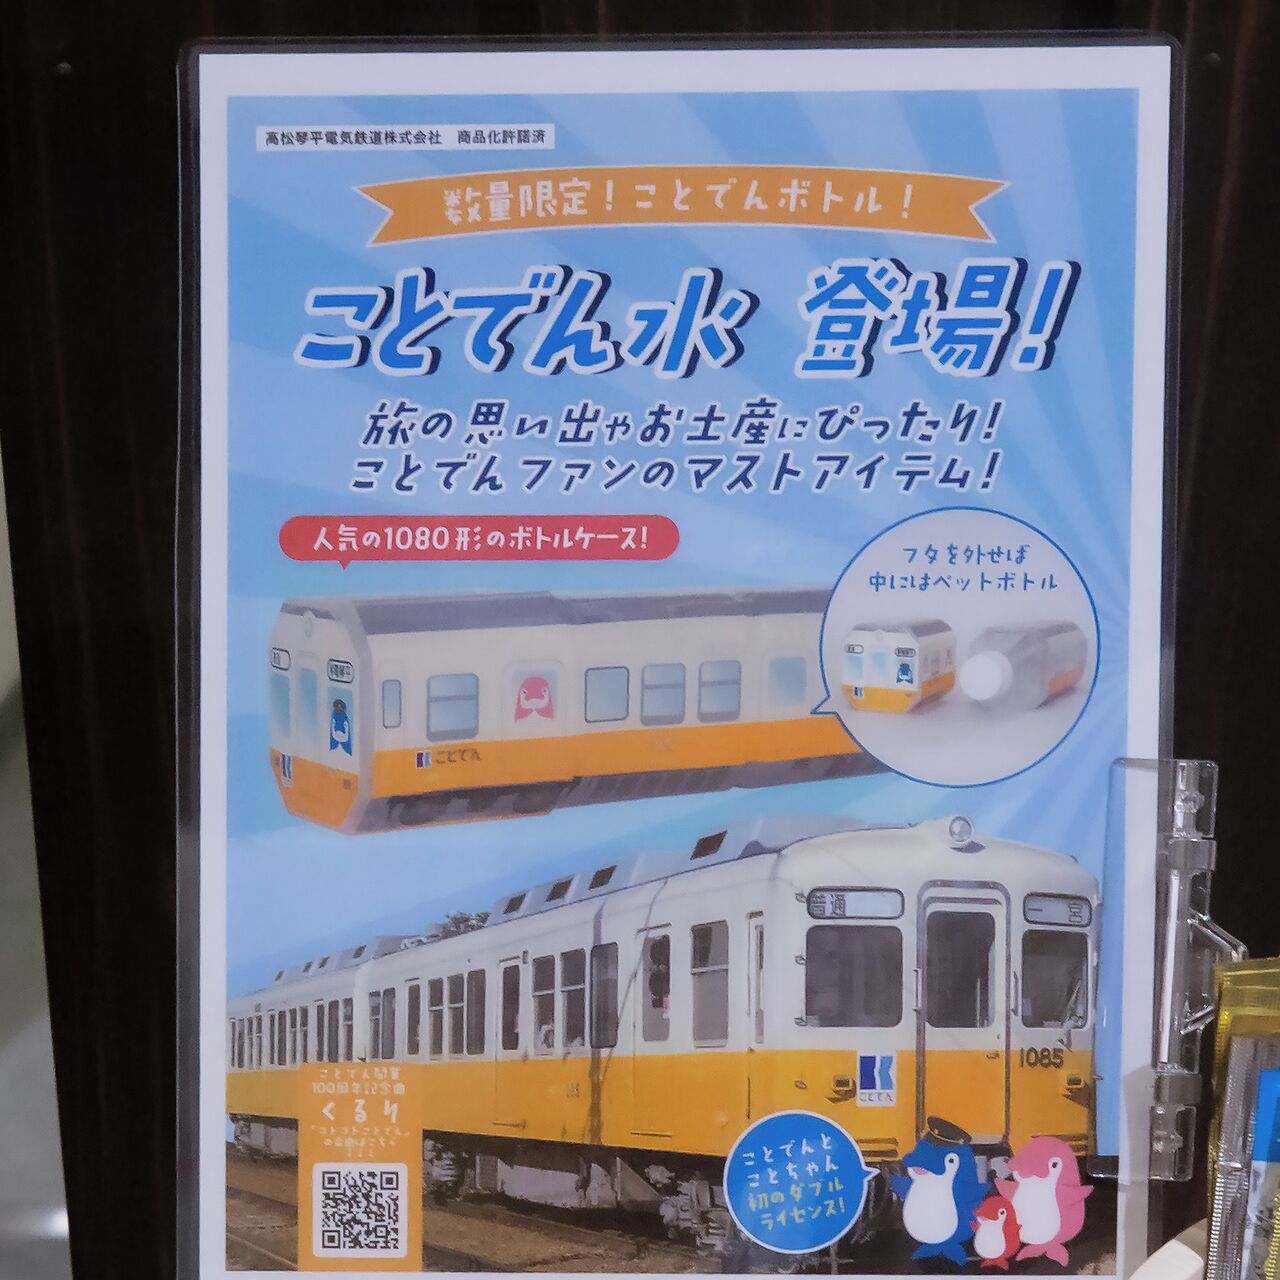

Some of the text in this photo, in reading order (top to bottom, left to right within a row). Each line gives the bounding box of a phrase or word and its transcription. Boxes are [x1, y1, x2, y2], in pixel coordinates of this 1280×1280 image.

[265, 129, 442, 146] 高松琴平電気鉄道株式会社
[294, 266, 758, 377] ことでん水
[902, 544, 1030, 565] フタを外せば
[869, 571, 1058, 592] 中にはペットボトル
[1019, 1047, 1064, 1069] 1085
[322, 1098, 399, 1123] くるり
[741, 1132, 833, 1167] ことでんと
